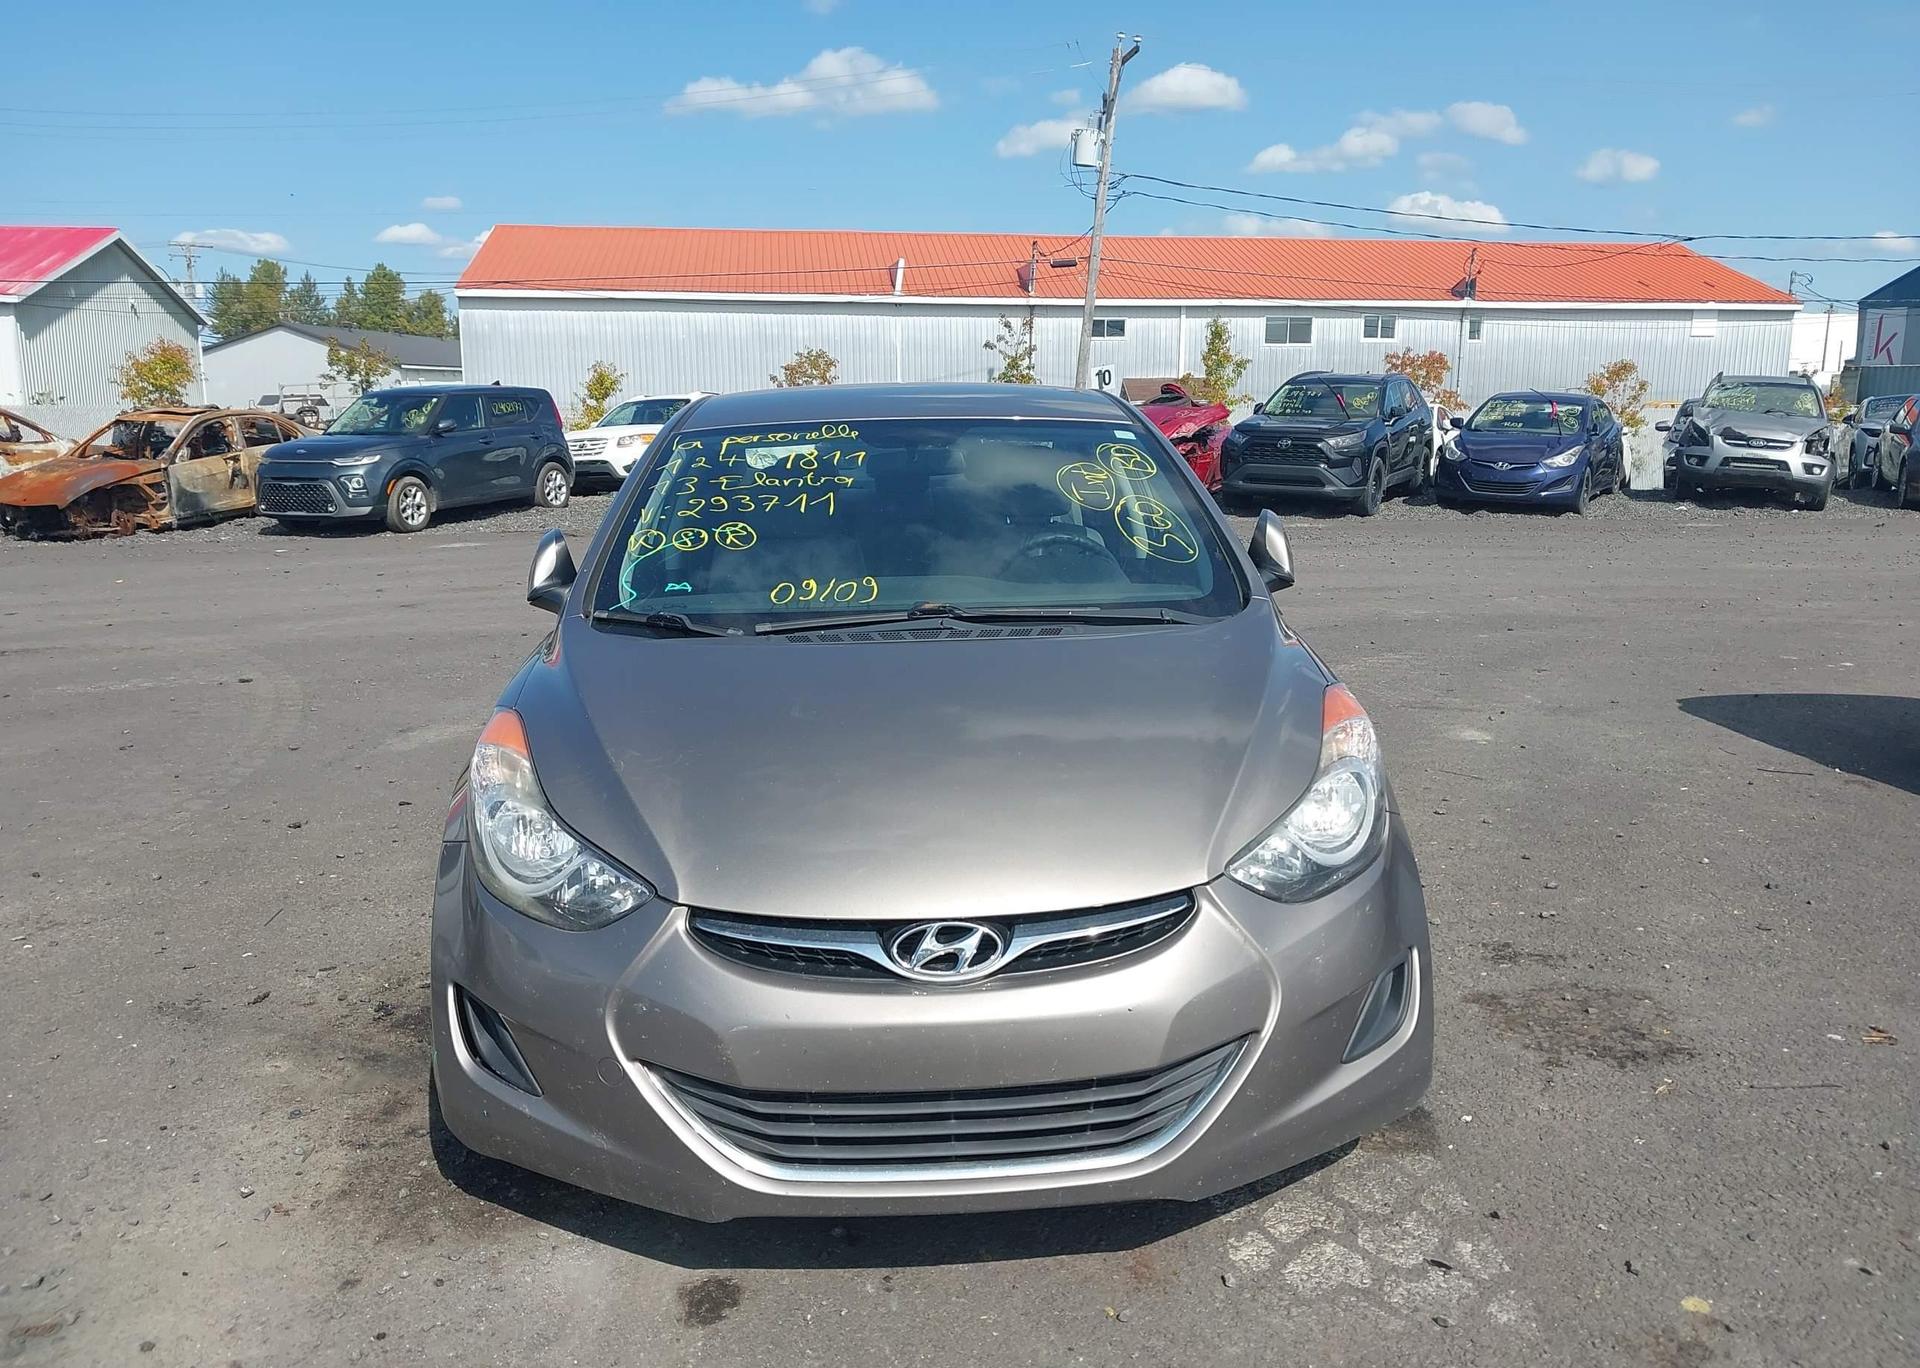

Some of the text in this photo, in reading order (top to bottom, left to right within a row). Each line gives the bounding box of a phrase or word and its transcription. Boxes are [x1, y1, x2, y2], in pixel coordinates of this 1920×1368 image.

[1095, 369, 1112, 387] 10
[676, 490, 835, 519] 293711
[770, 576, 878, 605] 09/09
